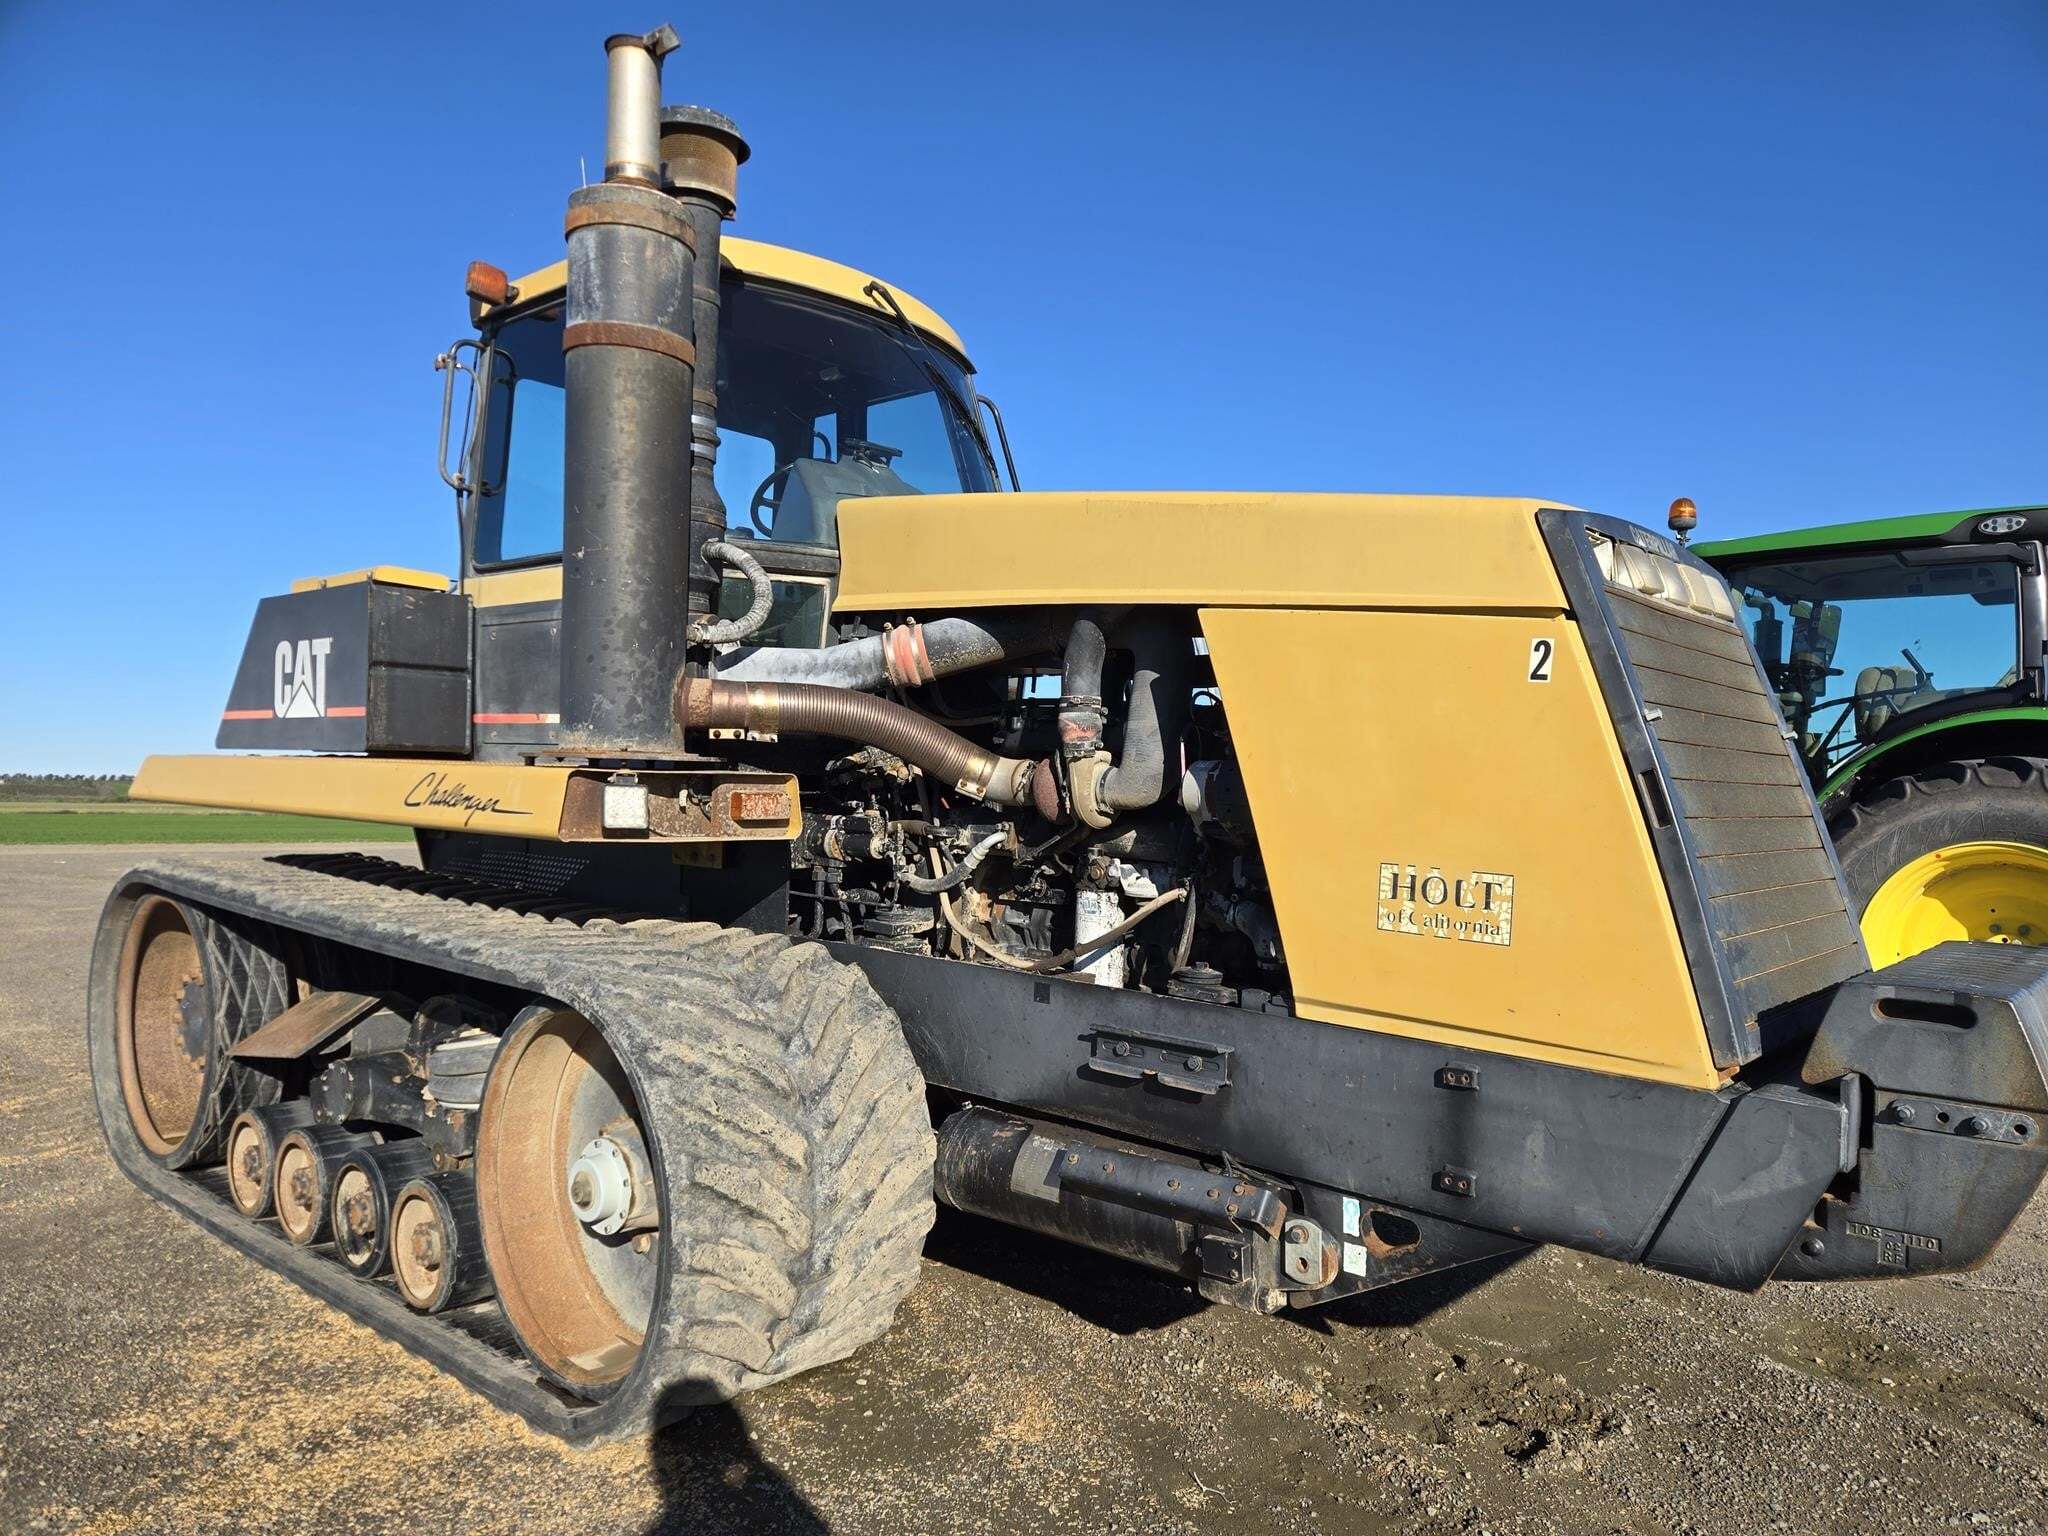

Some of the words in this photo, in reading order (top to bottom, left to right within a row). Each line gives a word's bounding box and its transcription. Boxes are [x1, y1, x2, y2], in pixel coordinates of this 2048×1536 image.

[274, 637, 331, 719] CAT
[1530, 640, 1552, 681] 2
[404, 771, 534, 827] Challenger
[1388, 872, 1503, 911] HOLT
